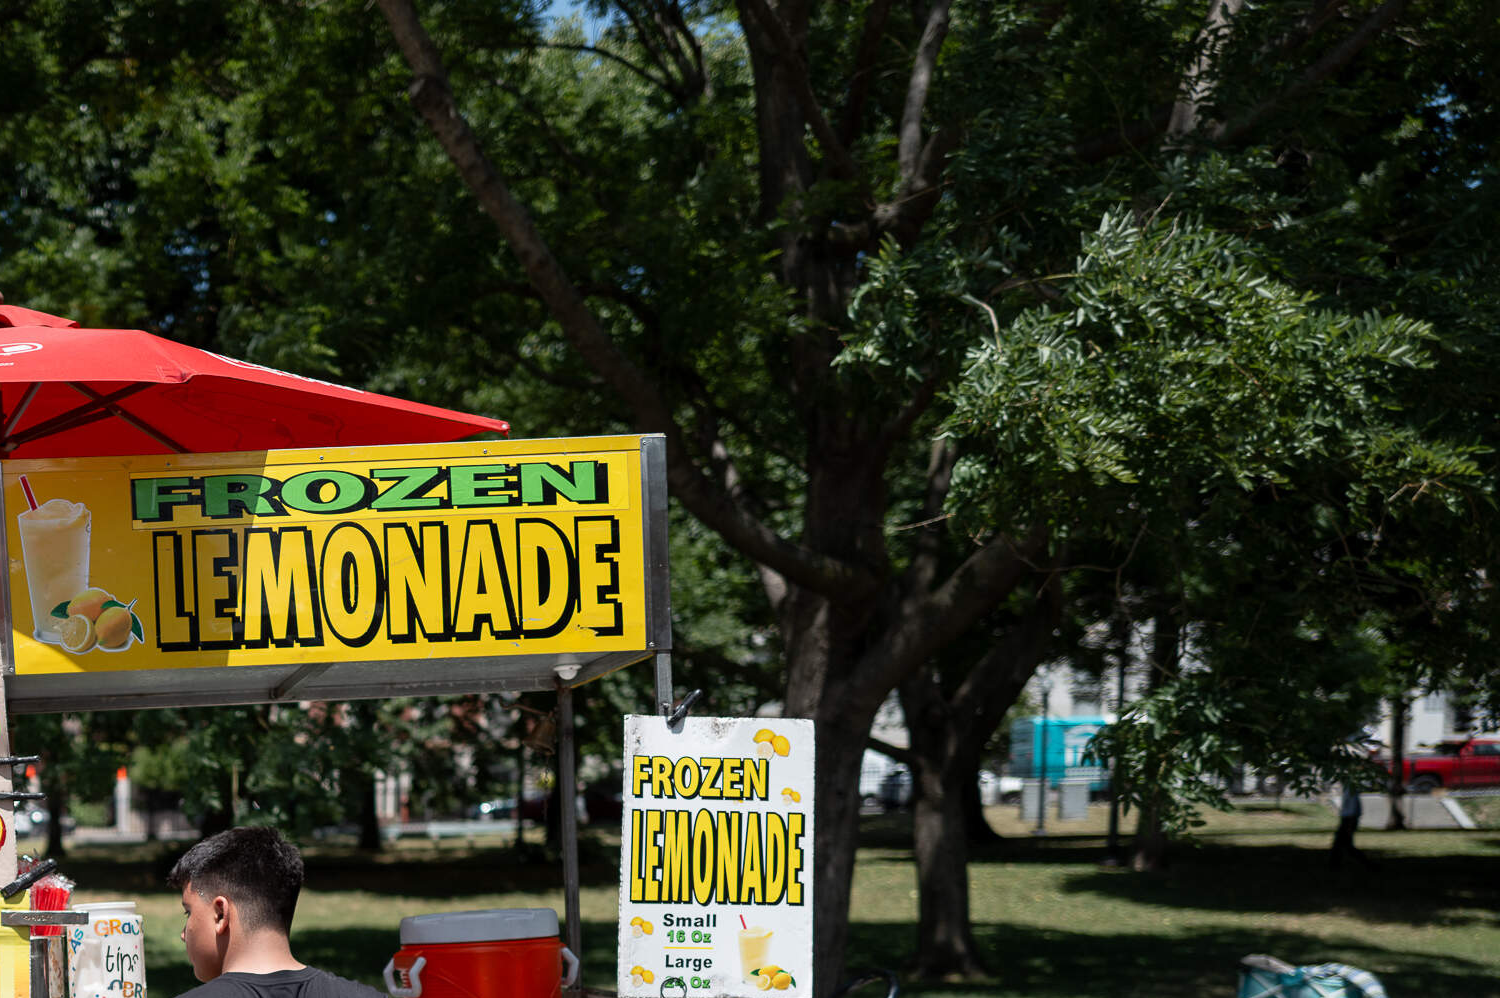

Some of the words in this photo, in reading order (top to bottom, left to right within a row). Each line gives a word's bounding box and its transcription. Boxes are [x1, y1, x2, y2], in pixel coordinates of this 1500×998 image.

[131, 460, 609, 522] FROZEN
[152, 515, 624, 652] LEMONADE
[632, 755, 769, 801] FROZEN
[629, 808, 805, 906] LEMONADE
[663, 913, 716, 927] Small
[667, 930, 685, 943] 16
[691, 930, 711, 943] Oz
[665, 954, 712, 971] Large
[690, 976, 710, 988] Oz
